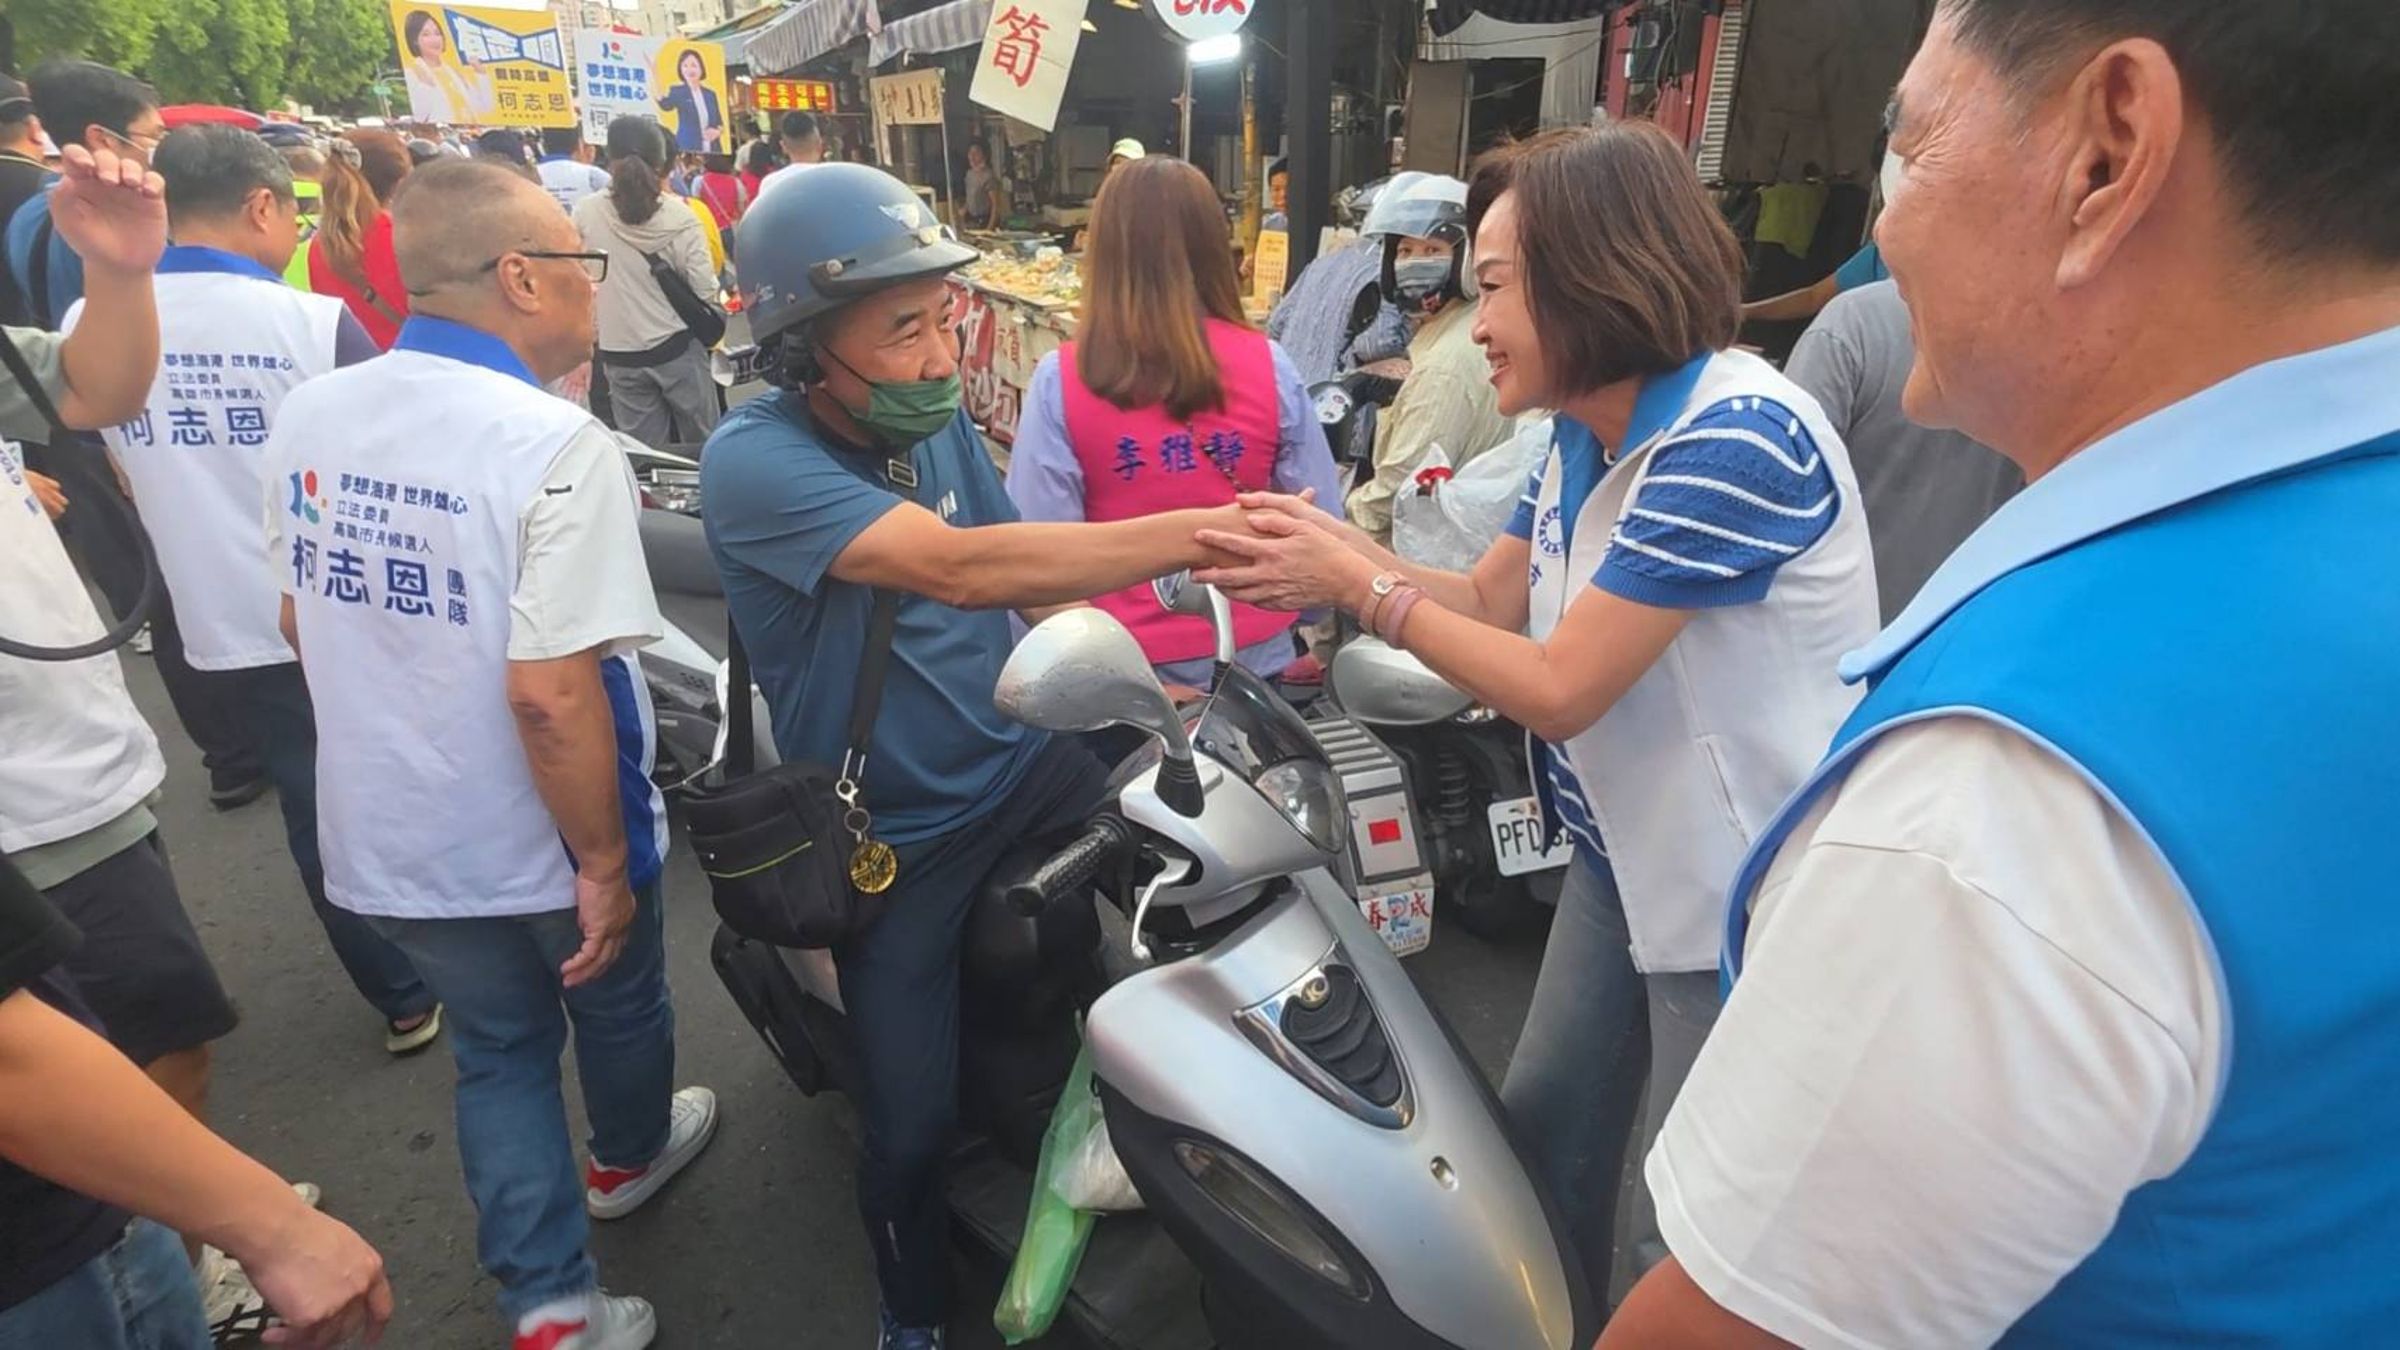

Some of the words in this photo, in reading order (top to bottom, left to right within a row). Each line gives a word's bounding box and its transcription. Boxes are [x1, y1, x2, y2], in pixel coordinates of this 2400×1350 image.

[994, 5, 1050, 88] 筍
[497, 91, 567, 111] 柯志恩
[335, 500, 390, 524] 立法委員
[291, 534, 436, 618] 柯志恩
[446, 568, 470, 627] 團隊
